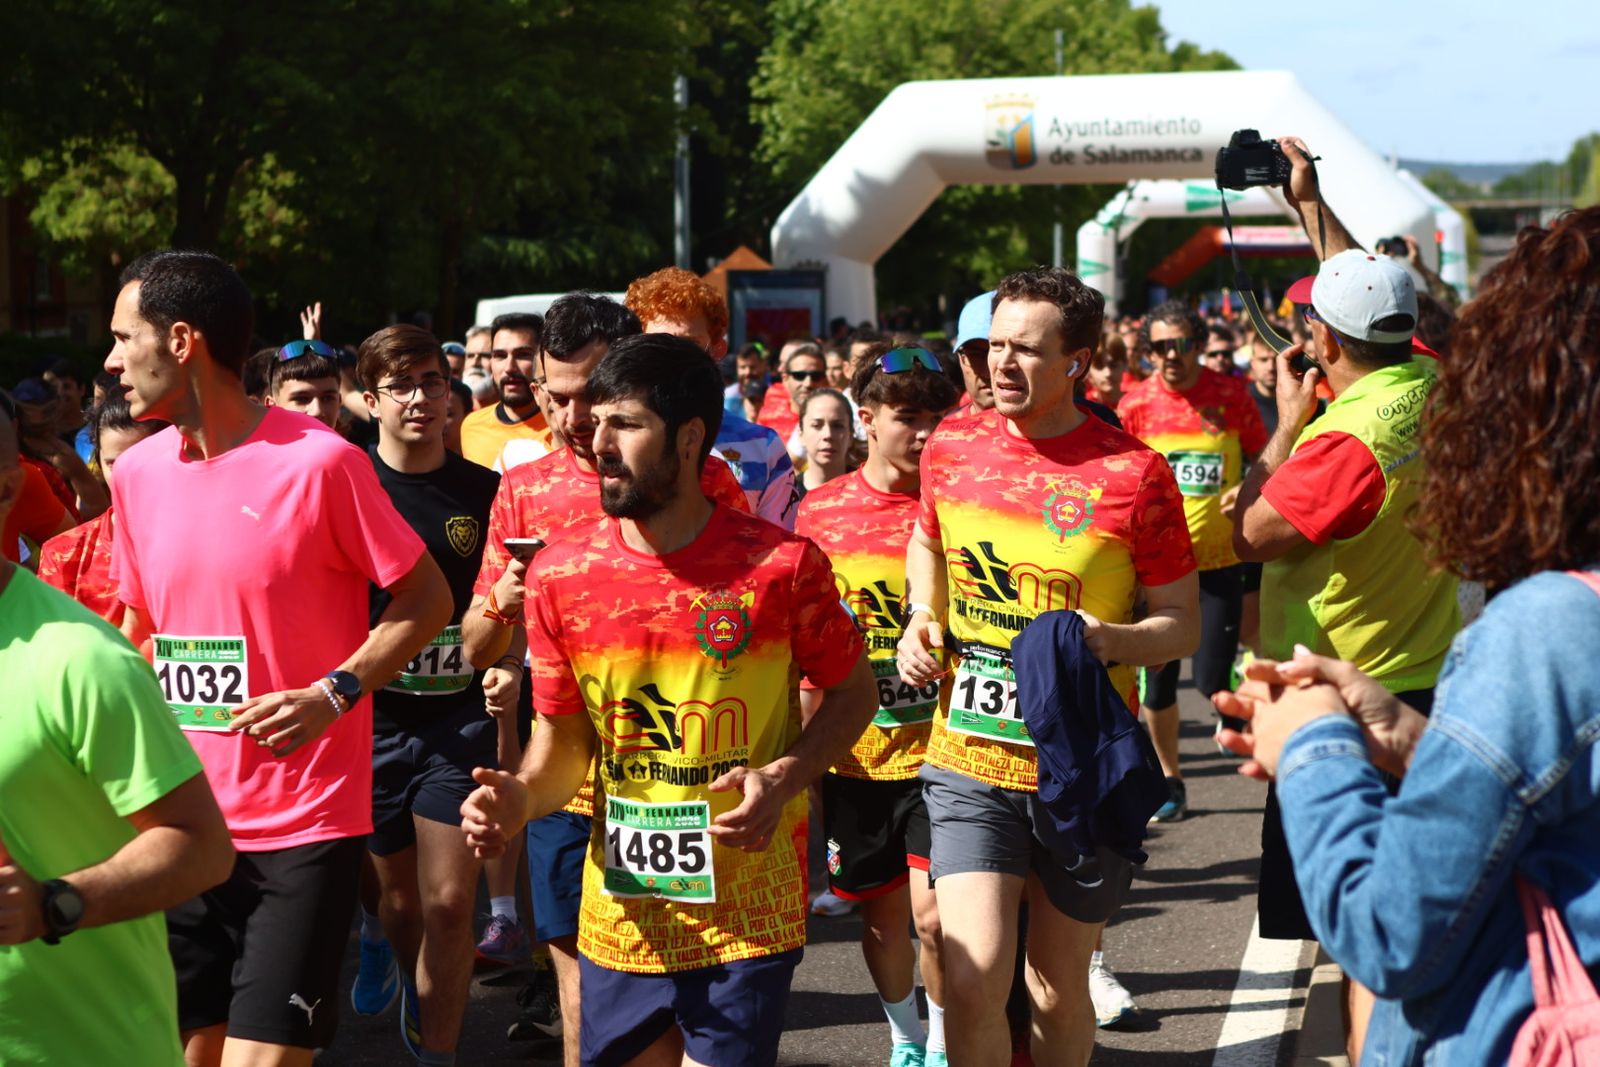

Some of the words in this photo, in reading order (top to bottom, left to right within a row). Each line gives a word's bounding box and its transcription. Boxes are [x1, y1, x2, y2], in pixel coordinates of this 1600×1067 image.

[1048, 117, 1202, 143] Ayuntamiento
[1050, 146, 1076, 165] de
[1083, 144, 1204, 165] Salamanca
[981, 607, 1034, 632] FERNAND
[154, 637, 172, 658] XIV
[174, 641, 187, 650] SAN
[195, 641, 241, 651] FERNANDO
[173, 649, 217, 659] CARRERA
[158, 663, 243, 704] 1032
[609, 800, 625, 822] XIV
[625, 805, 639, 816] SAN
[646, 806, 704, 818] FERNANDO
[626, 814, 673, 827] CARRERA
[608, 826, 706, 874] 1485
[749, 918, 767, 933] POR
[769, 915, 778, 929] EL
